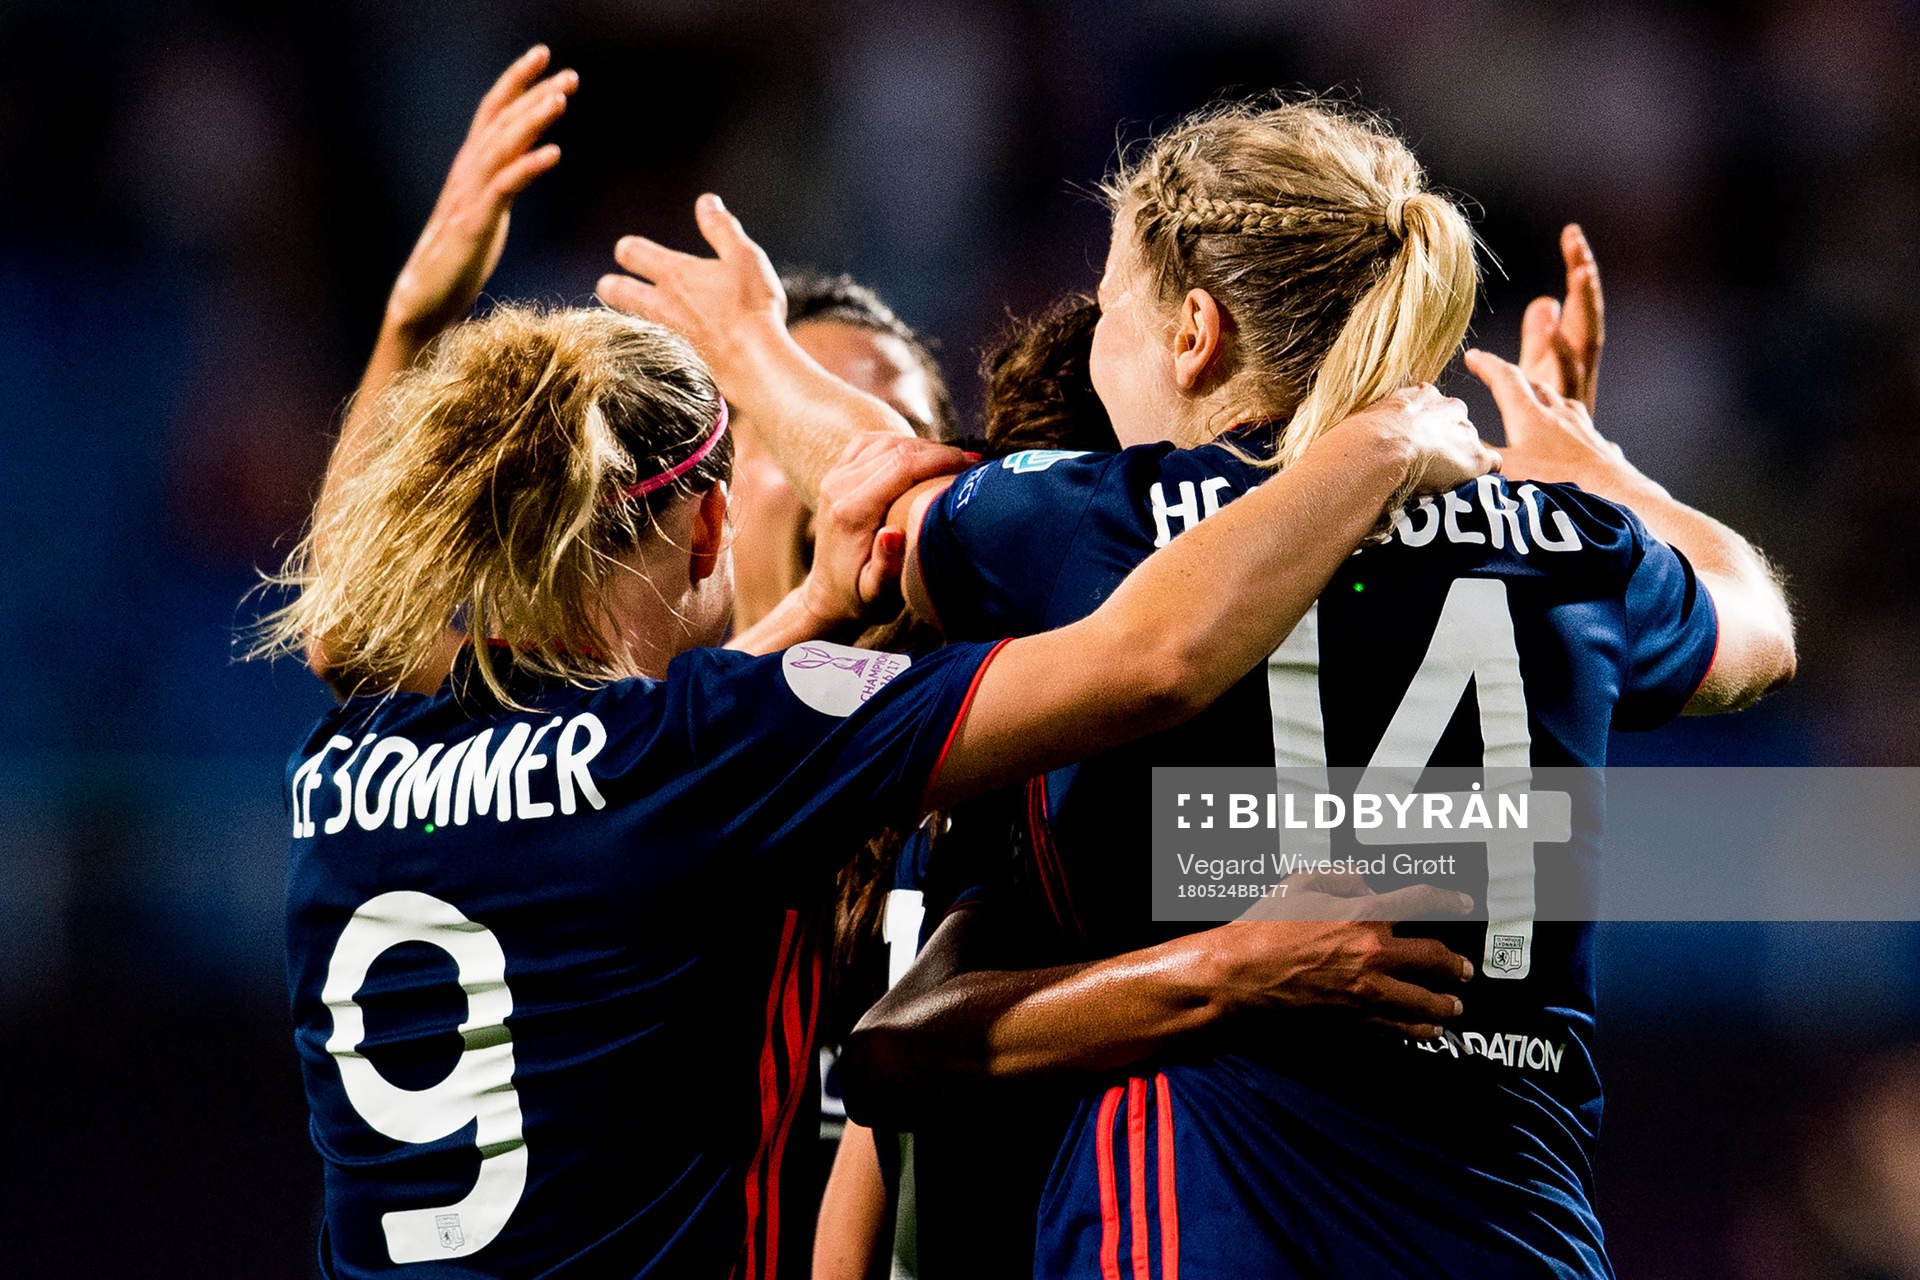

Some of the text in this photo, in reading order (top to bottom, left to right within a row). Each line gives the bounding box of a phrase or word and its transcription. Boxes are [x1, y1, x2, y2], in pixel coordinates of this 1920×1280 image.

[1149, 473, 1583, 555] HEBERG
[292, 711, 608, 839] LE SOMMER
[1266, 577, 1572, 980] 14
[321, 890, 529, 1265] 9
